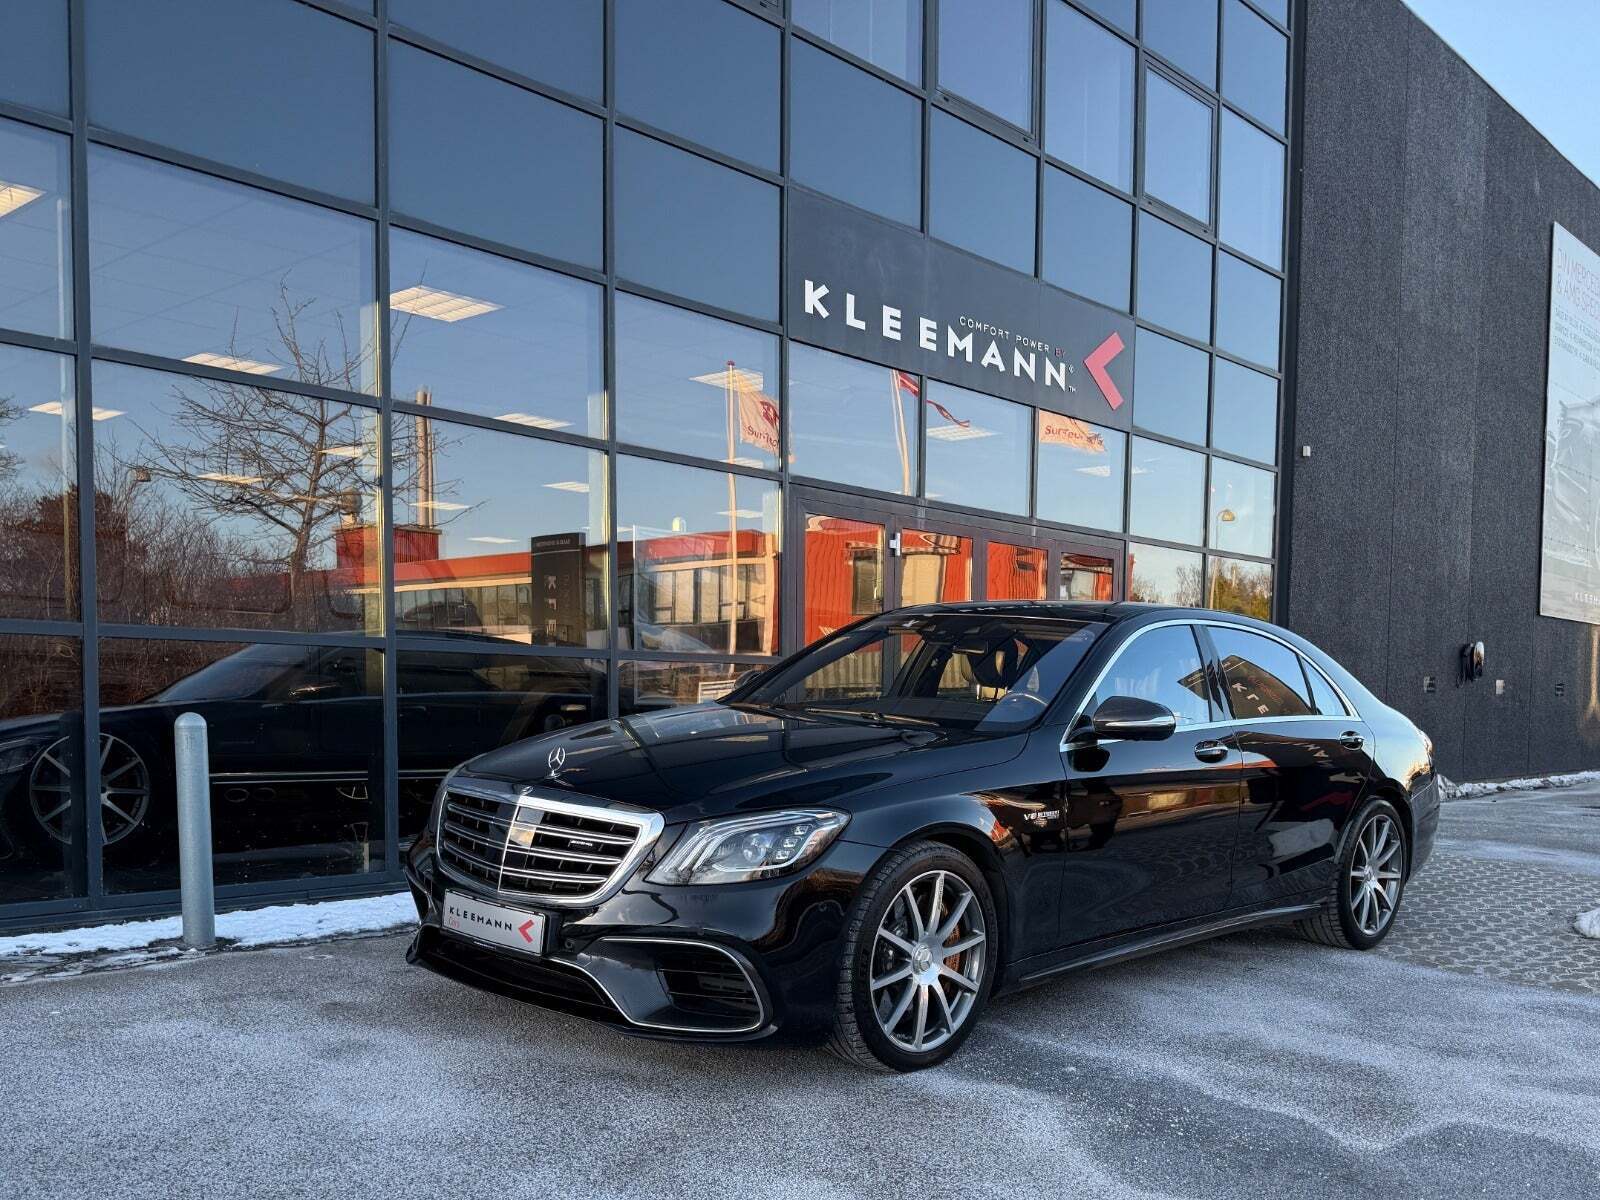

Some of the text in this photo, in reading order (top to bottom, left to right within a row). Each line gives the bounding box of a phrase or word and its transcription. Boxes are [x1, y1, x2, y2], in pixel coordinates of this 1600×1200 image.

[803, 279, 1066, 392] KLEEMANN
[959, 316, 1009, 340] COMFORT
[1015, 334, 1049, 353] POWER
[449, 906, 512, 931] KLEEMANN
